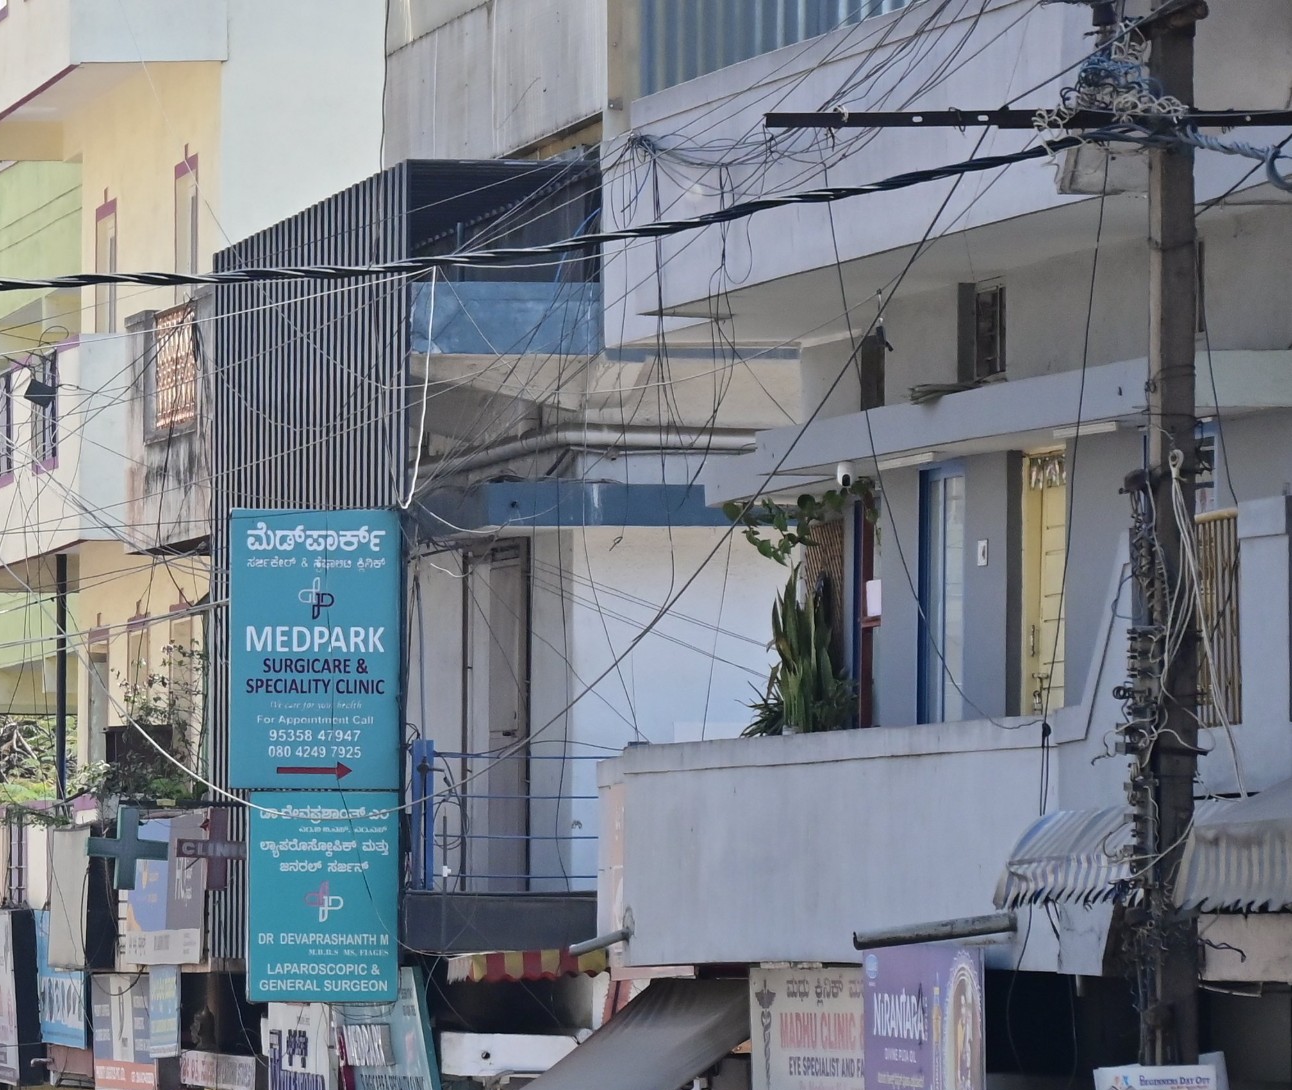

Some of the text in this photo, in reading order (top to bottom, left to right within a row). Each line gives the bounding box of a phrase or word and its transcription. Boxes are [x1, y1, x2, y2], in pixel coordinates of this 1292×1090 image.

[301, 558, 309, 568] &
[246, 626, 385, 653] MEDPARK
[263, 658, 369, 674] SURGICARE &
[246, 678, 385, 694] SPECIALITY CLINIC
[302, 700, 315, 711] for
[336, 700, 362, 710] health
[257, 715, 374, 726] For Appointment Call
[269, 729, 361, 742] 95358 47947
[268, 746, 362, 758] 080 4249 7925
[258, 933, 389, 945] DR DEVAPRASHANTH M
[267, 963, 380, 975] LAPAROSCOPIC &
[259, 980, 388, 991] GENERAL SURGEON
[780, 1011, 856, 1051] MADHU CLINIC
[789, 1056, 801, 1076] EYE
[803, 1056, 839, 1078] SPECIALIST
[841, 1058, 855, 1078] AND
